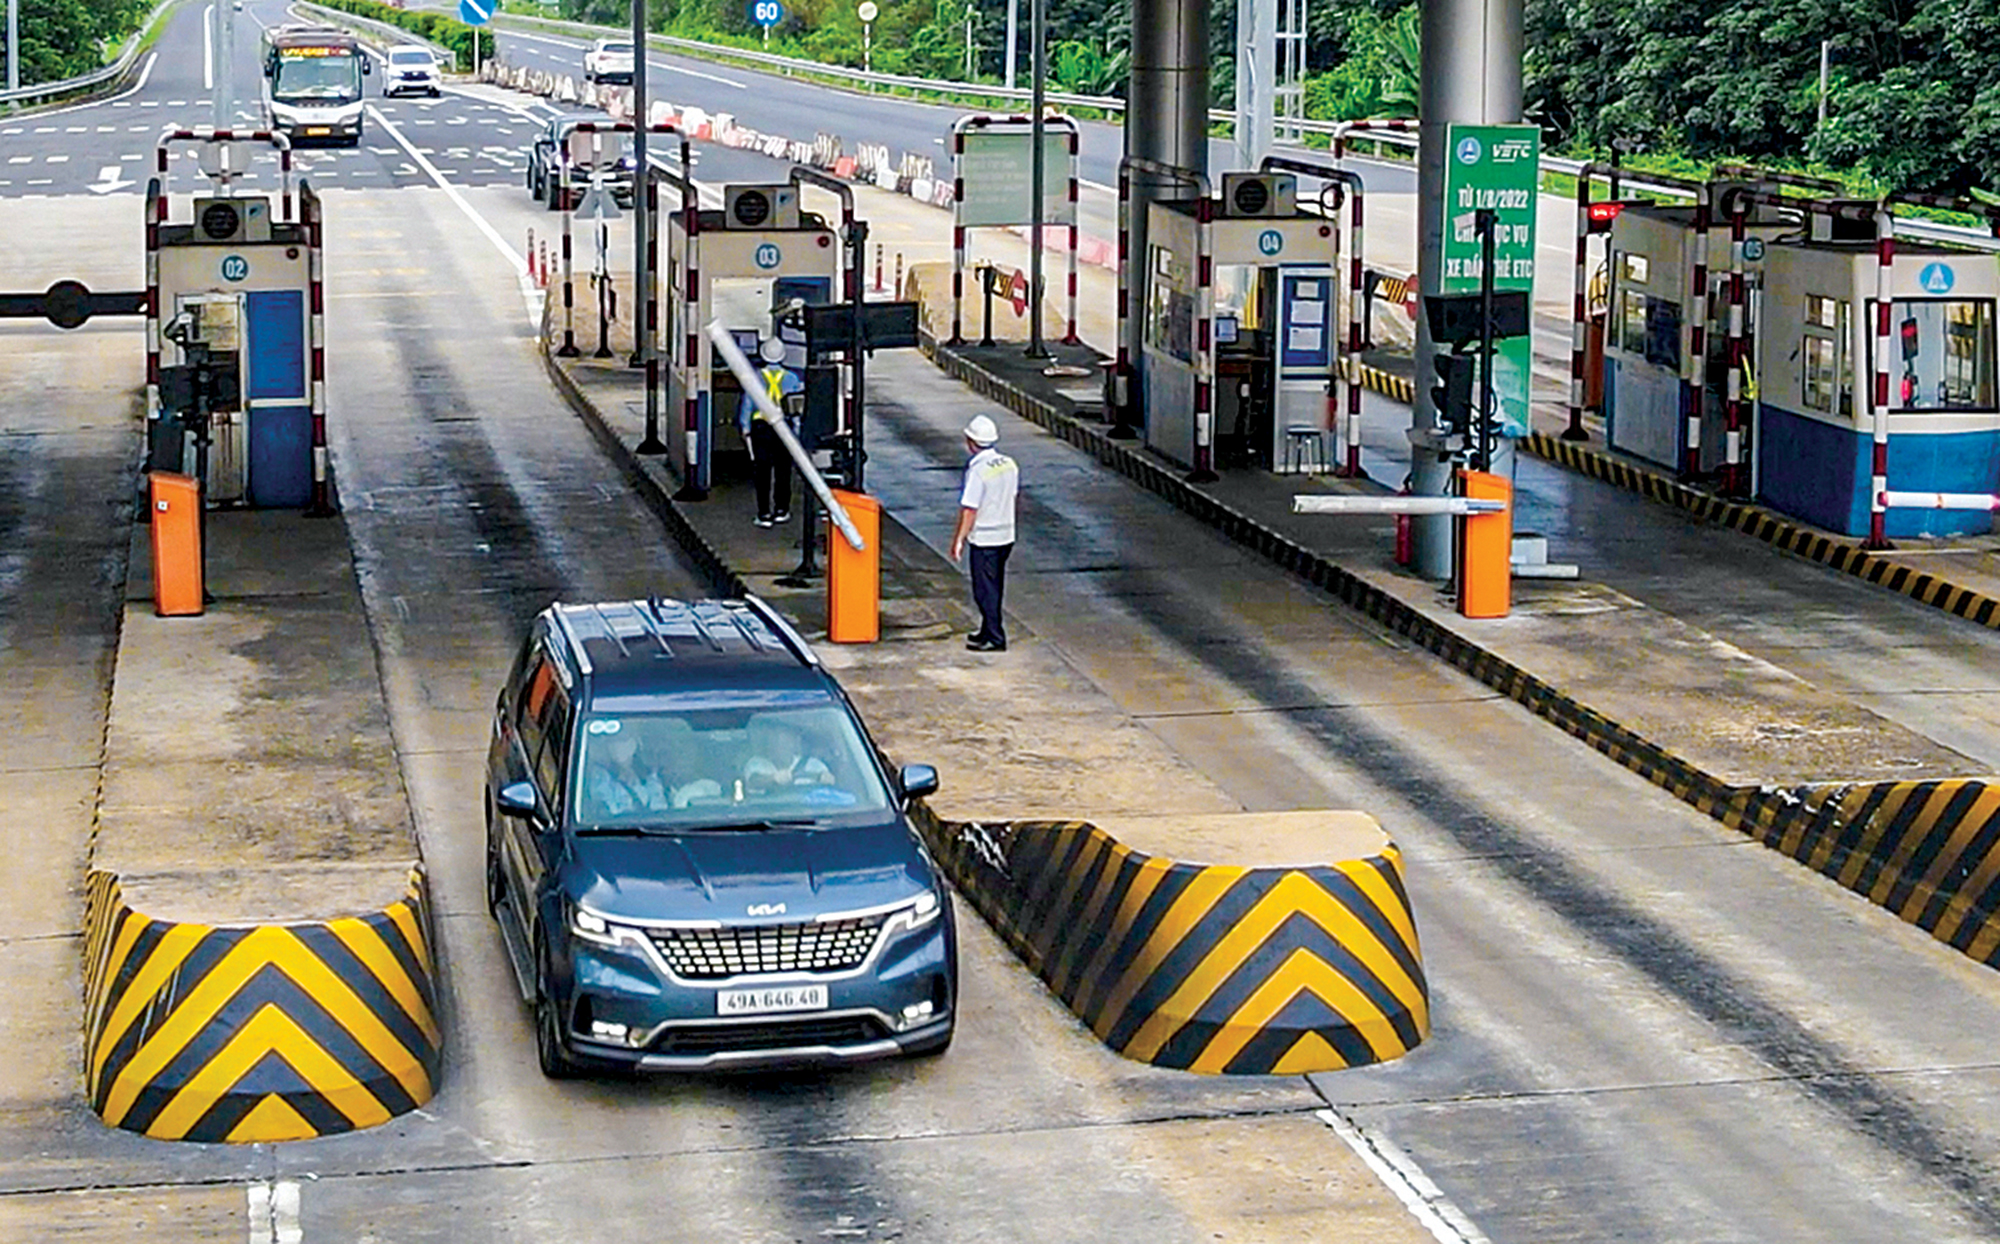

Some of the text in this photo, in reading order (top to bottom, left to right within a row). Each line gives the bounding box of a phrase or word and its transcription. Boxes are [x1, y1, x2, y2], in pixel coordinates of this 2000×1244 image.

[756, 2, 778, 20] 60
[1493, 140, 1532, 162] VETC
[1458, 182, 1528, 209] TỪ 1/8/2022
[1263, 234, 1279, 252] 04
[1513, 225, 1529, 248] VỤ
[759, 247, 777, 265] 03
[1746, 241, 1761, 258] 05
[225, 260, 244, 278] 02
[1446, 258, 1461, 278] XE
[1513, 259, 1533, 279] ETC
[747, 902, 786, 916] KIA
